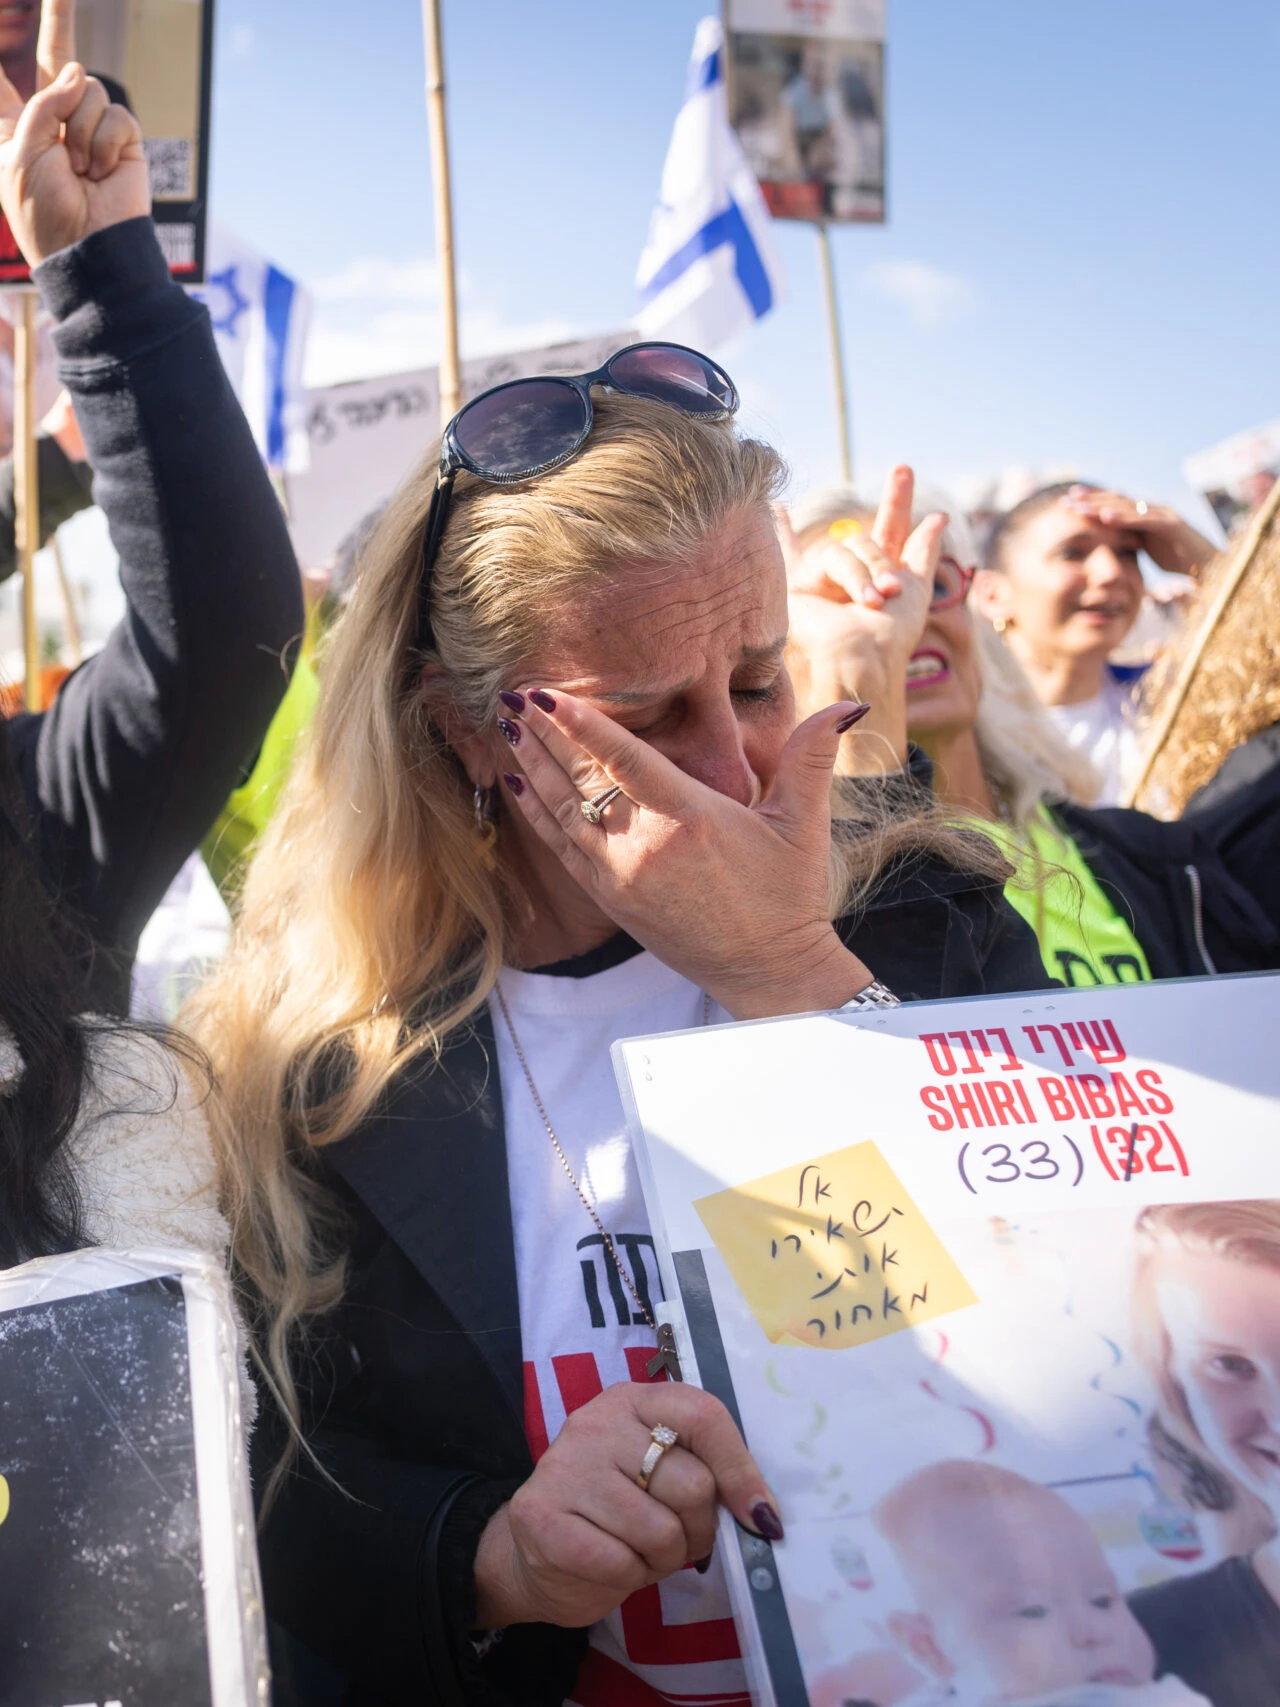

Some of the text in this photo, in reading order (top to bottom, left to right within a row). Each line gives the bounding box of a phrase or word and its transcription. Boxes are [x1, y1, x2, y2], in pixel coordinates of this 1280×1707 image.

[918, 1018, 1127, 1077] שירי ביבס
[919, 1068, 1175, 1132] SHIRI BIBAS
[797, 1165, 833, 1209] אל
[958, 1134, 1084, 1194] (33)
